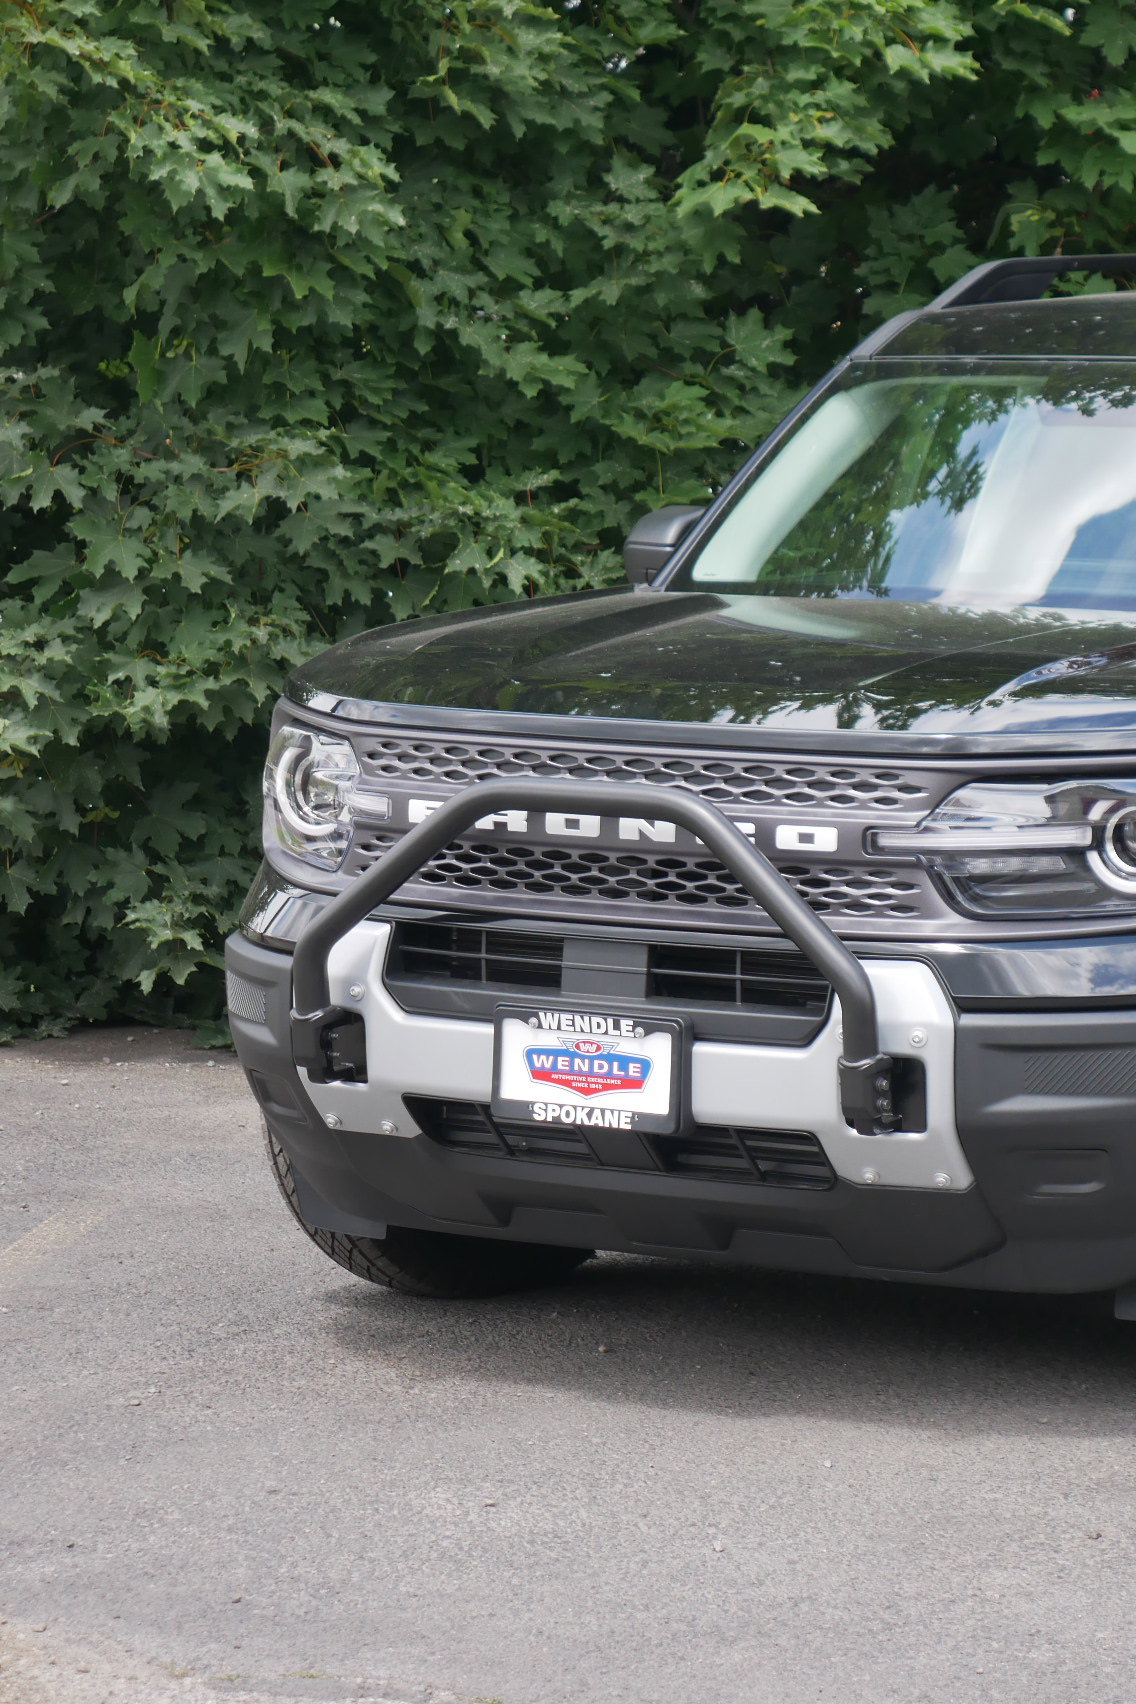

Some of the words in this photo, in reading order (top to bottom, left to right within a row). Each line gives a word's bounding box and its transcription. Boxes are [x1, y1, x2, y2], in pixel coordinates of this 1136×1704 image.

[539, 1012, 634, 1037] WENDLE
[532, 1054, 642, 1076] WENDLE
[551, 1073, 587, 1082] AUTOMOTIVE
[587, 1077, 622, 1085] EXCELLENCE
[532, 1102, 632, 1130] SPOKANE
